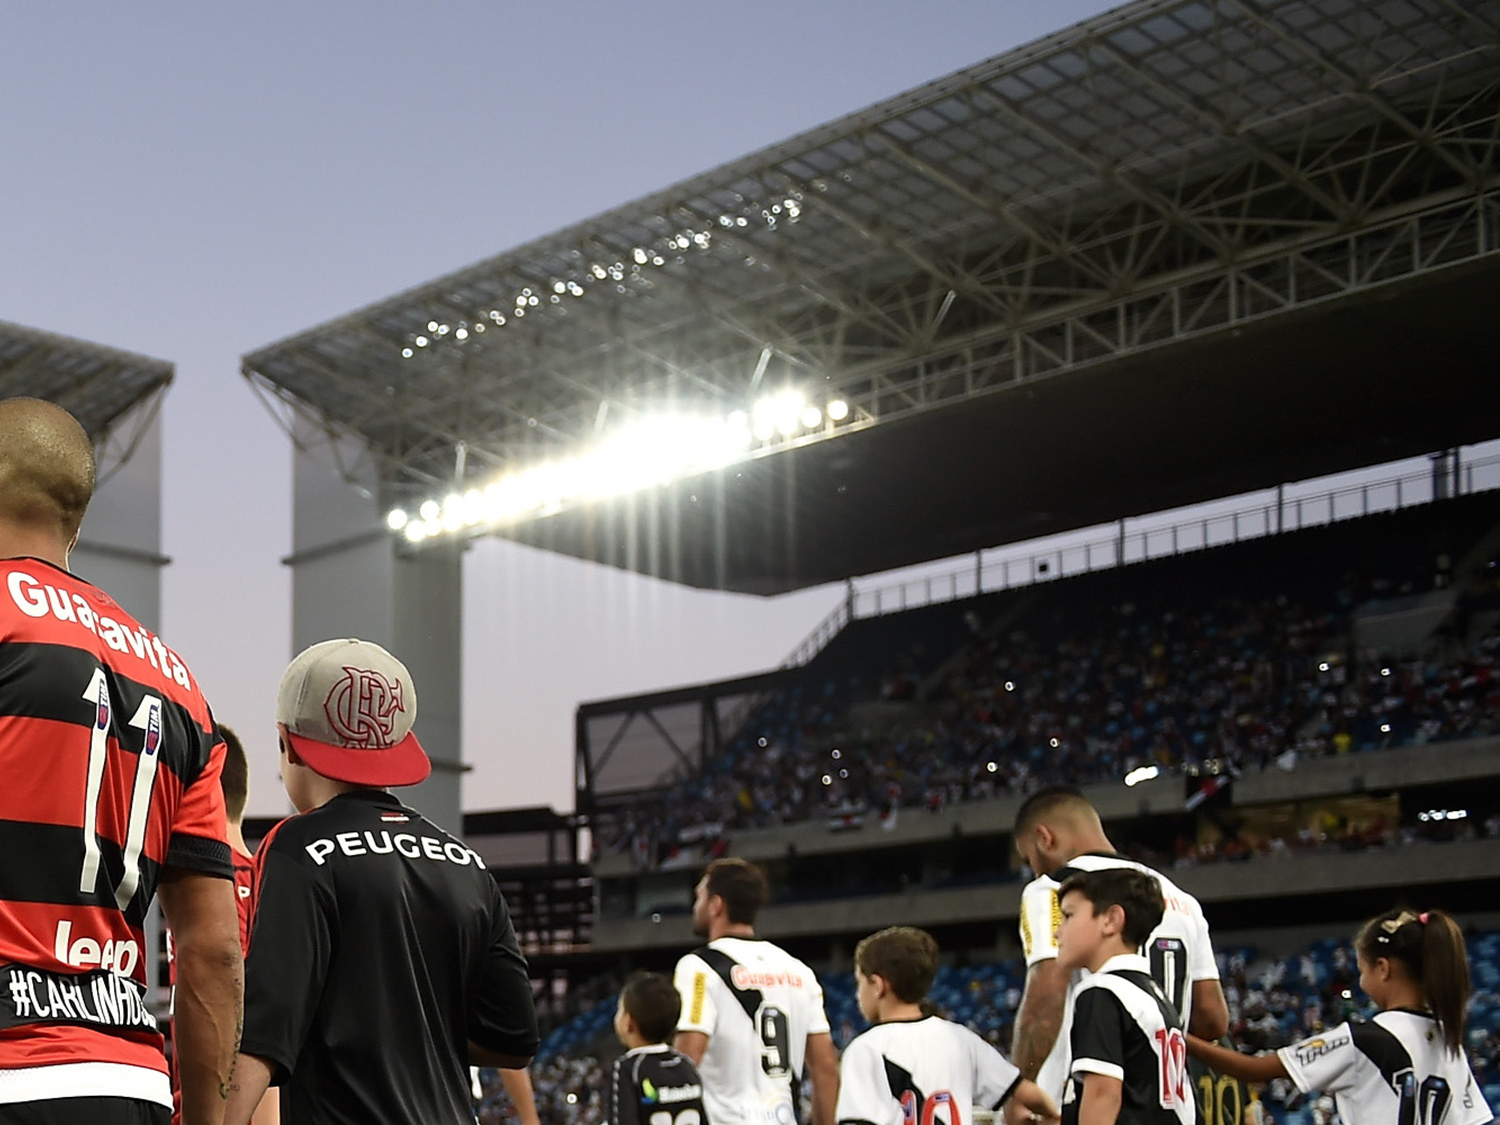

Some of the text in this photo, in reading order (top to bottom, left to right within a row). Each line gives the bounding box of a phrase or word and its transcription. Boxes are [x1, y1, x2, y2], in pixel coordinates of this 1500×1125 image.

[7, 572, 191, 690] Guaravita
[80, 667, 162, 911] 11
[305, 830, 486, 870] PEUGEOT
[758, 1005, 791, 1077] 9
[1155, 1028, 1188, 1104] 10
